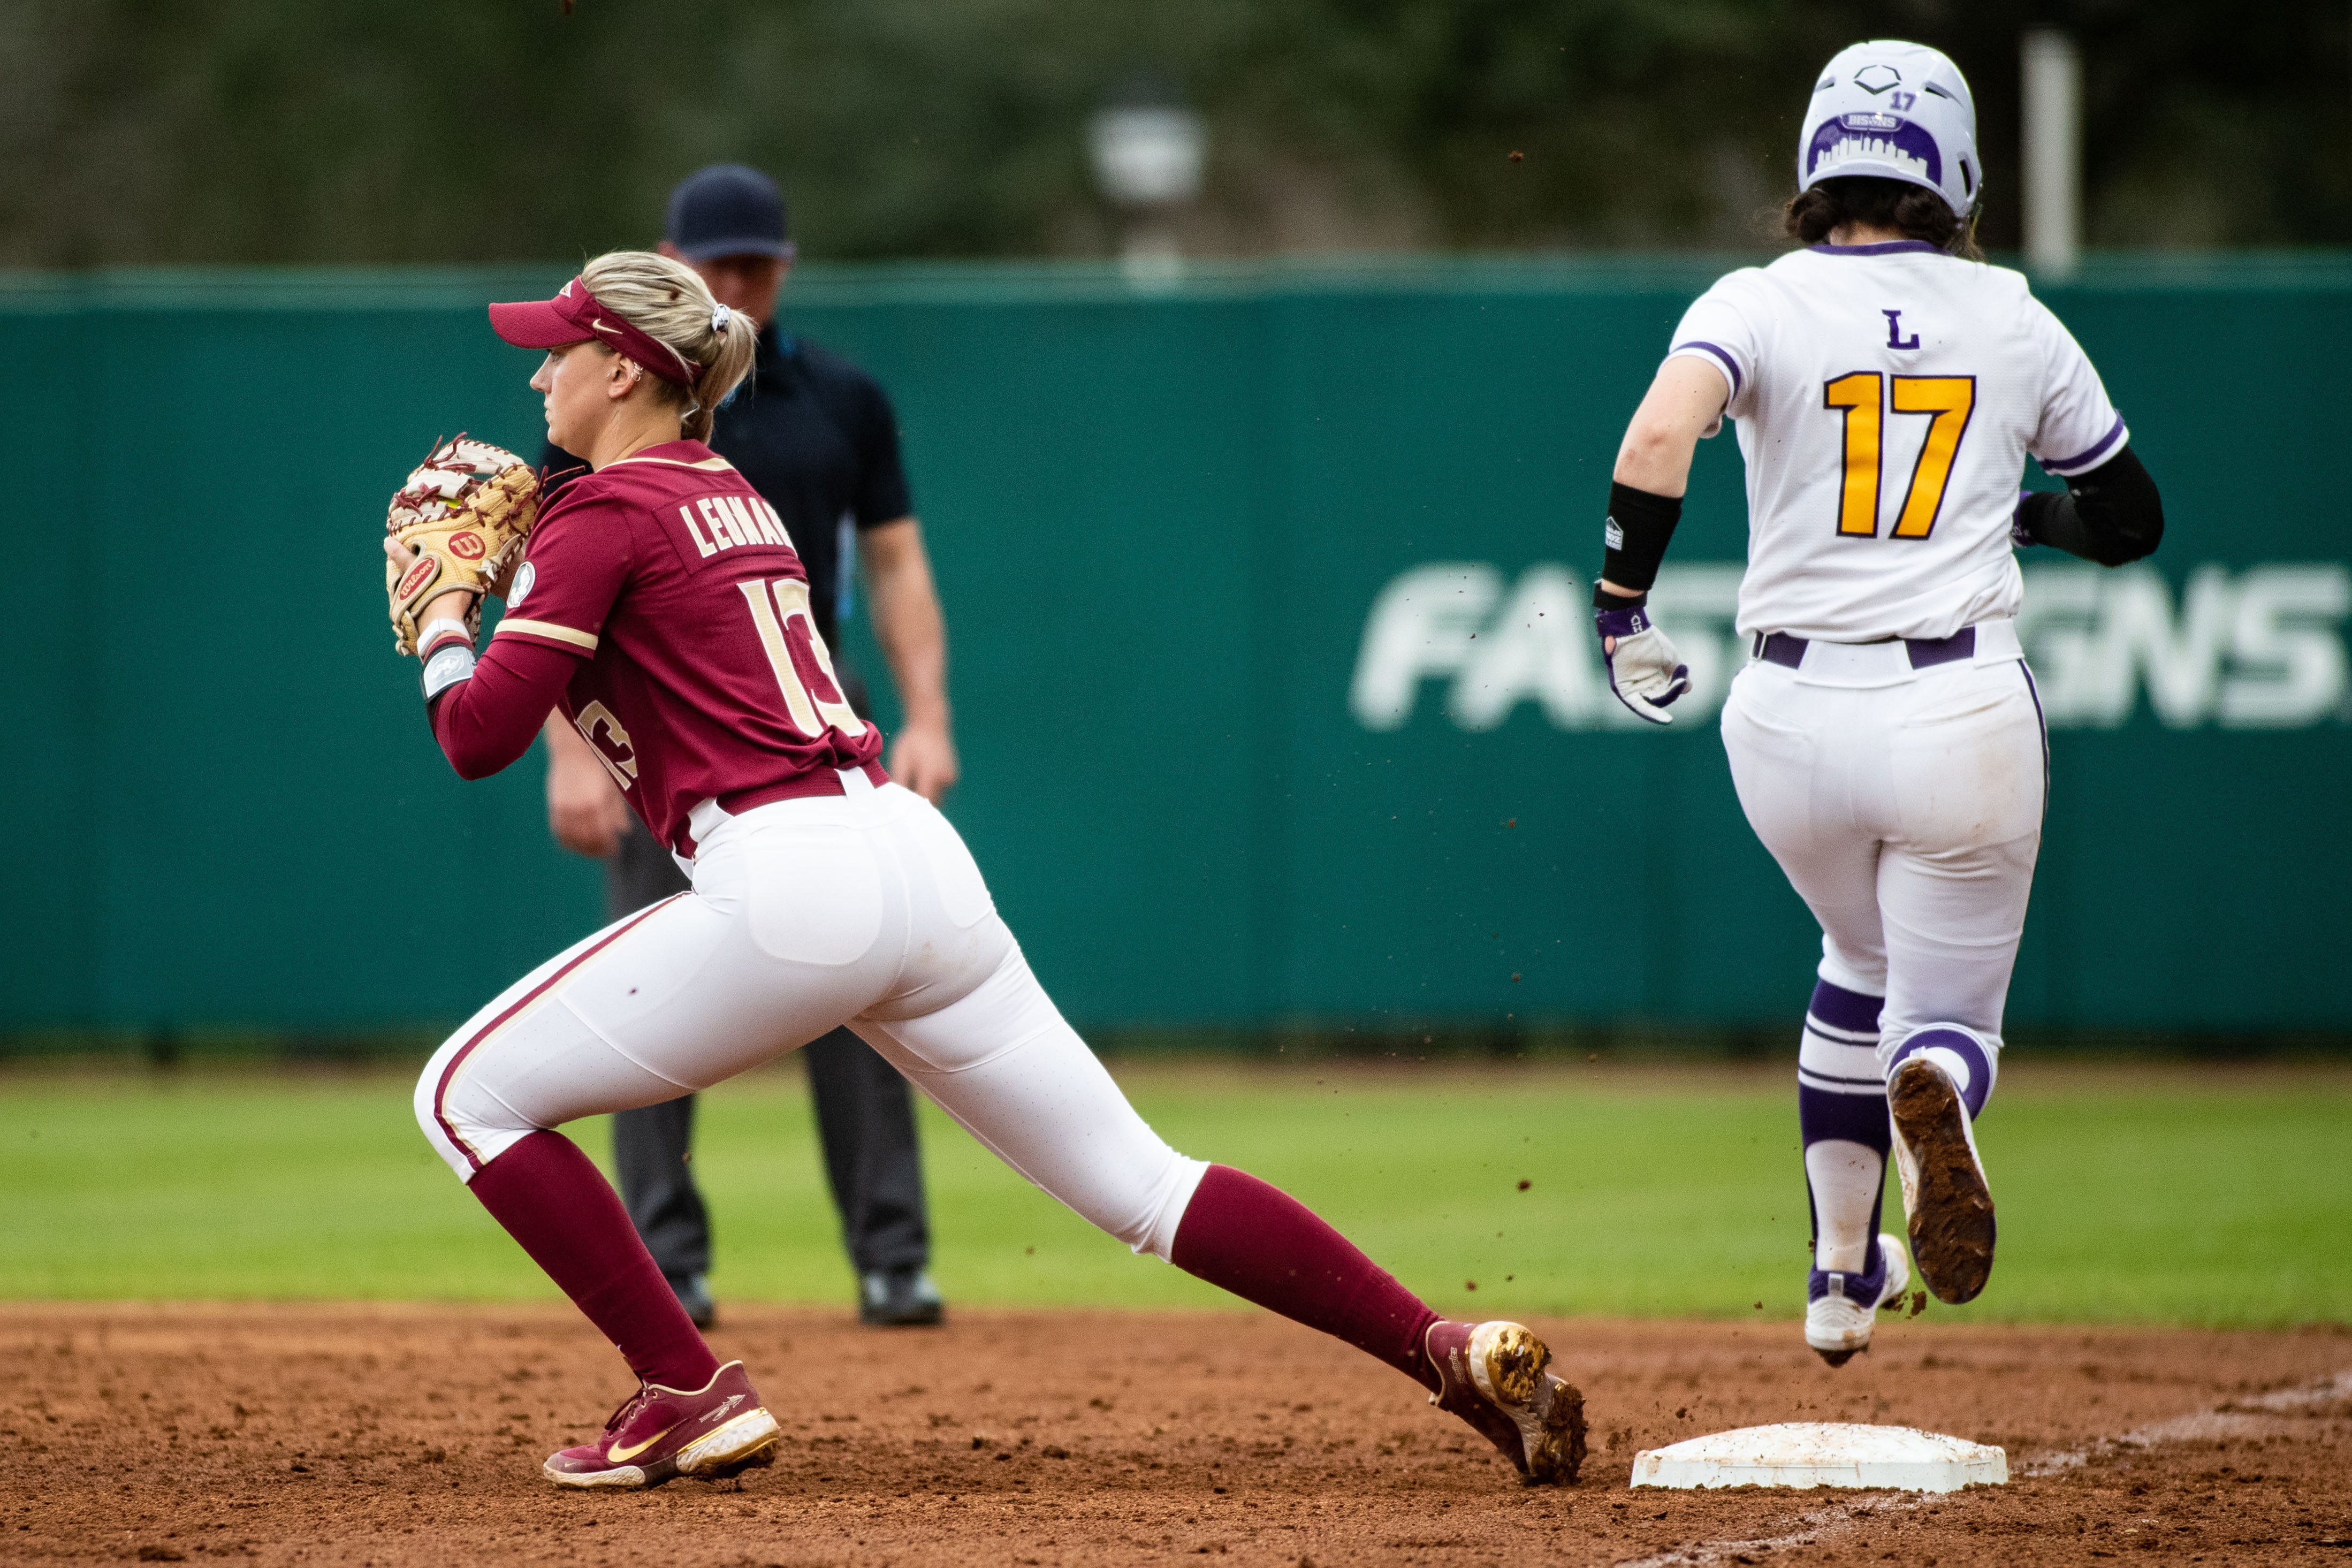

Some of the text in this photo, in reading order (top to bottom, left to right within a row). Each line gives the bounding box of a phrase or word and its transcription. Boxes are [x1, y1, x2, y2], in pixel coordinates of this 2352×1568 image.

[1890, 90, 1916, 112] 17
[1882, 309, 1920, 349] L
[1823, 370, 1976, 540] 17
[400, 561, 432, 596] Wilson
[736, 579, 868, 737] 13
[1350, 562, 2349, 730] FASGNS
